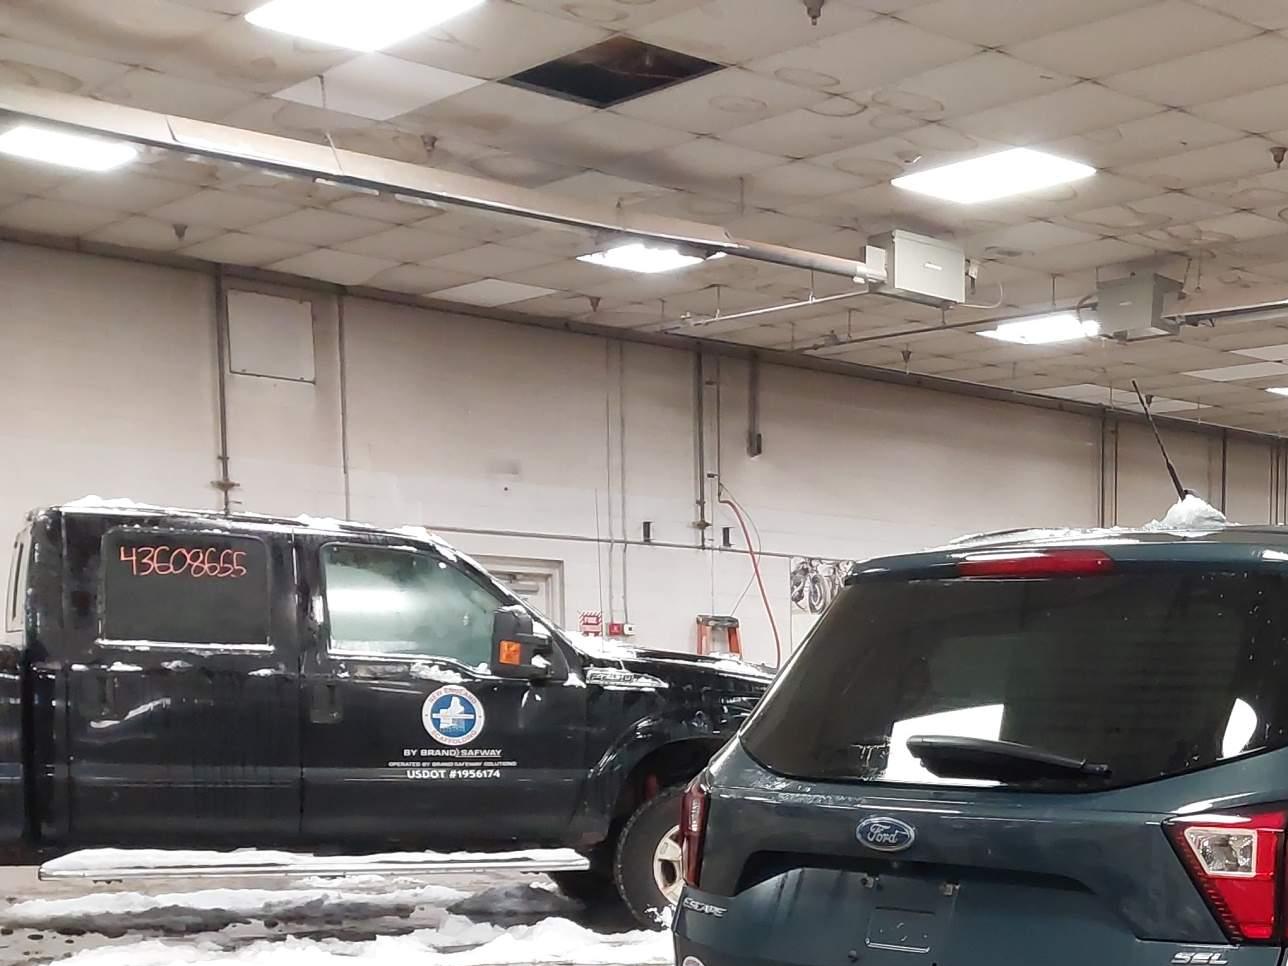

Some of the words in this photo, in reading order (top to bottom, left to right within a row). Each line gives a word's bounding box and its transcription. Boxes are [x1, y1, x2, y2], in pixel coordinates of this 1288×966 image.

[120, 546, 247, 578] 43608655
[403, 749, 418, 757] BY
[407, 769, 447, 779] USDOT
[449, 769, 501, 779] #1956174
[683, 897, 728, 917] ESCAPE
[1171, 952, 1228, 965] SEL
